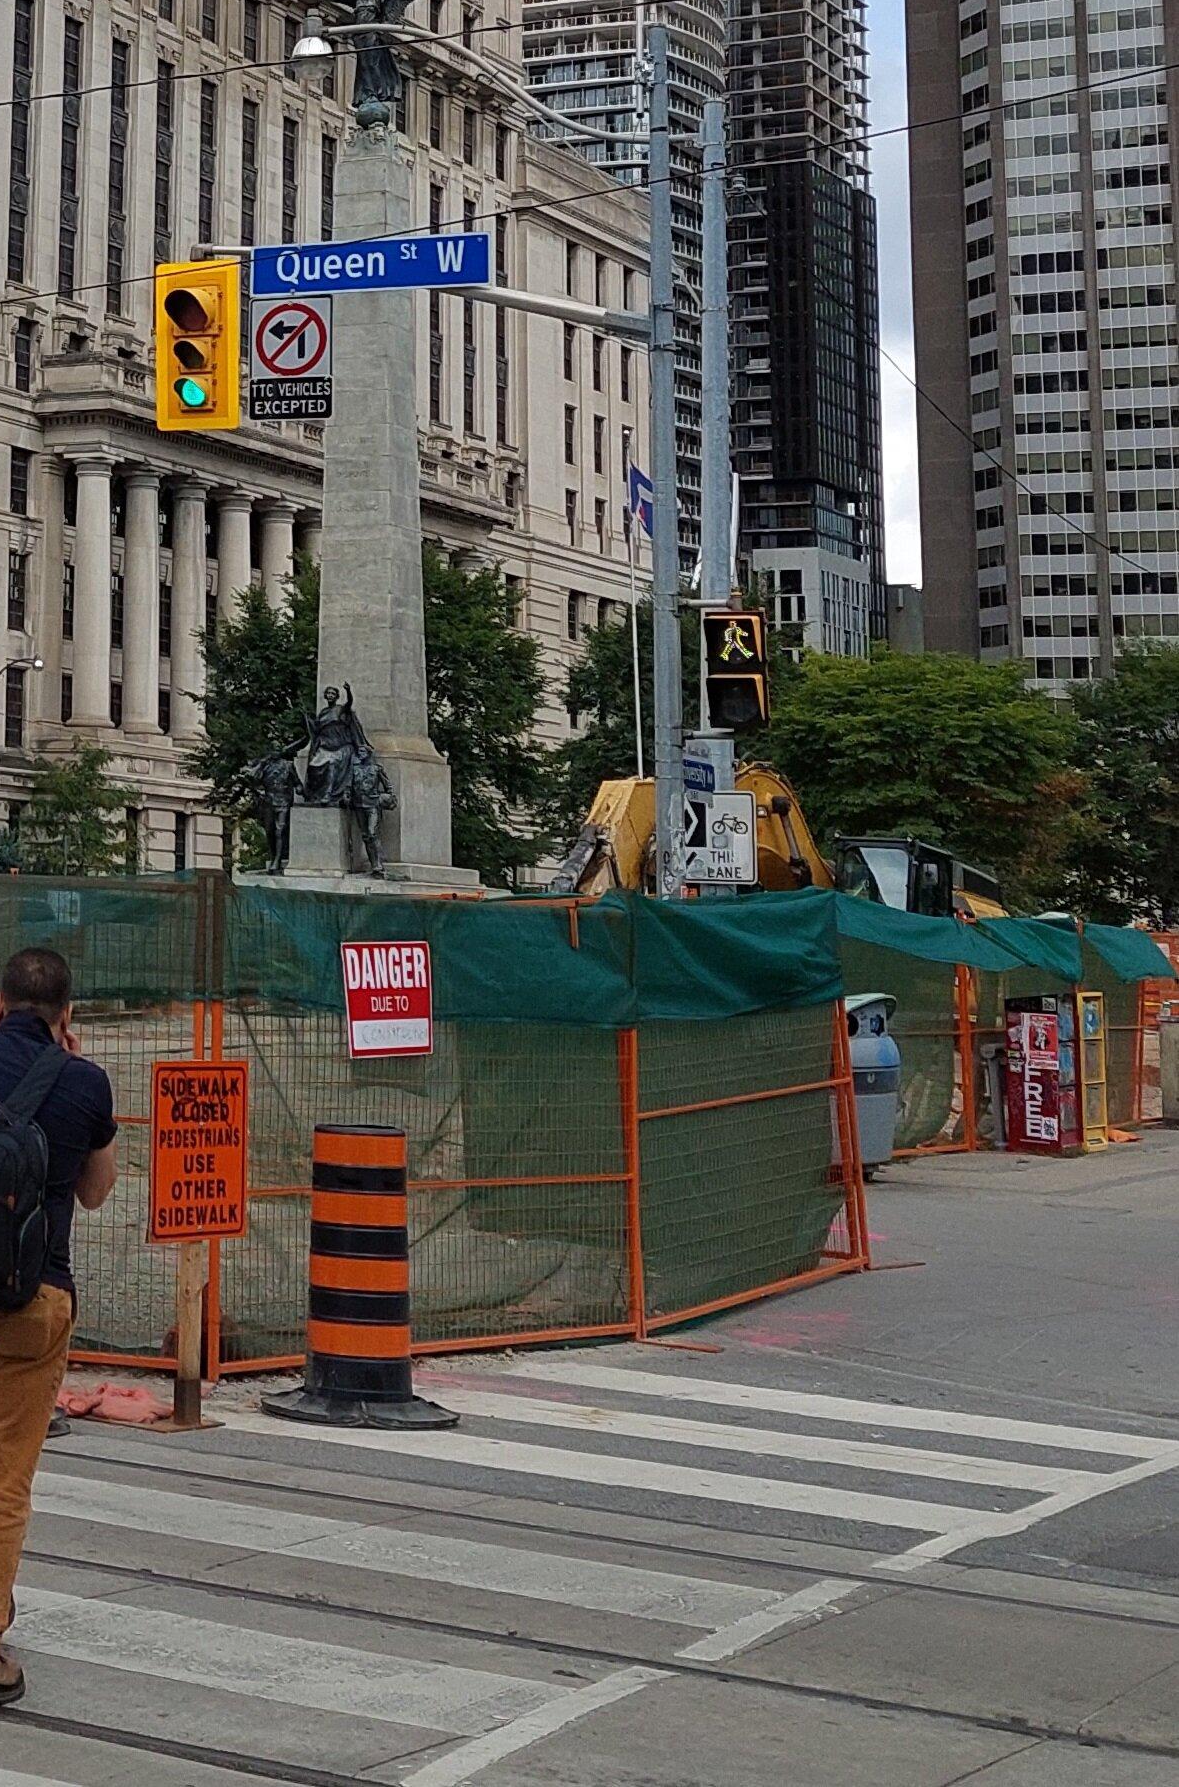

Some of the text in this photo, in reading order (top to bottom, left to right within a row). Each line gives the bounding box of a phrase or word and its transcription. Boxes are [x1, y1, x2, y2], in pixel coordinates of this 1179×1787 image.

[276, 240, 465, 285] Queen St W
[252, 381, 331, 398] TTC VEHICLES
[254, 399, 327, 415] EXCEPTED
[707, 867, 742, 879] LANE
[345, 947, 427, 989] DANGER
[371, 995, 409, 1012] DUE TO
[160, 1077, 240, 1098] SIDEWALK
[172, 1100, 230, 1123] CLOSED
[1024, 1064, 1043, 1138] FREE
[159, 1127, 240, 1149] PEDESTRIANS
[183, 1153, 216, 1175] USE
[171, 1180, 227, 1202] OTHER
[158, 1204, 238, 1229] SIDEWALK
